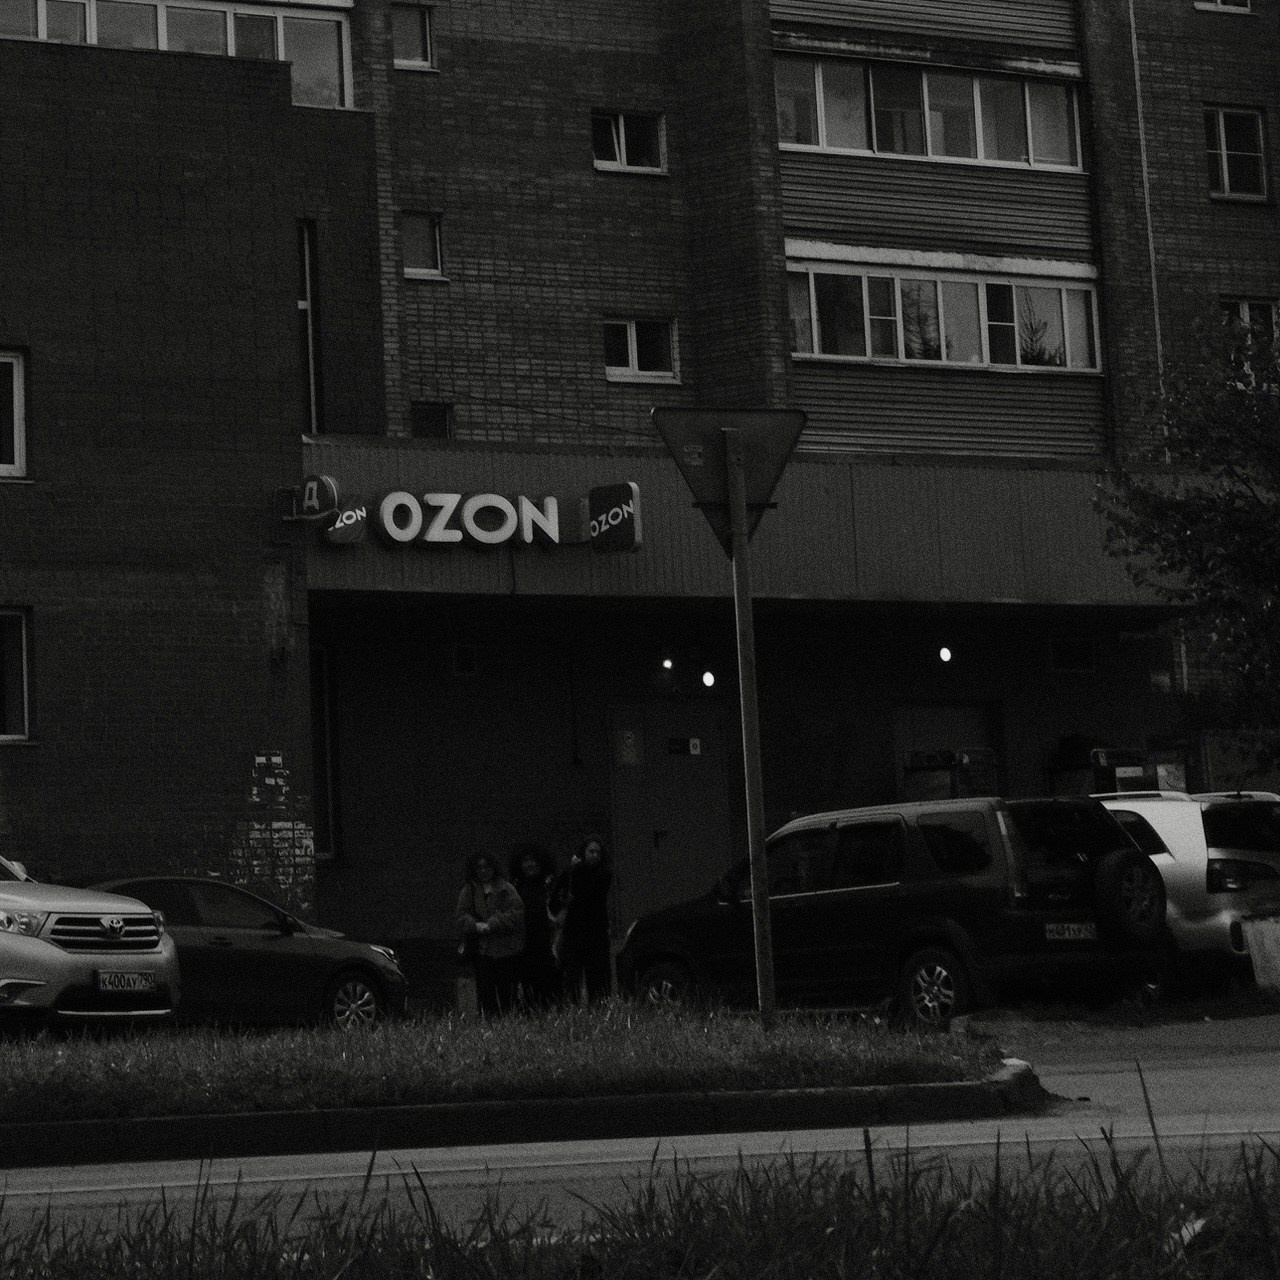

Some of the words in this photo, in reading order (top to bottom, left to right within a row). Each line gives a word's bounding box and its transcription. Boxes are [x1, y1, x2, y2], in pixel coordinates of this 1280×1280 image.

[327, 506, 367, 532] ZON
[379, 491, 560, 545] OZON
[589, 499, 634, 538] OZON
